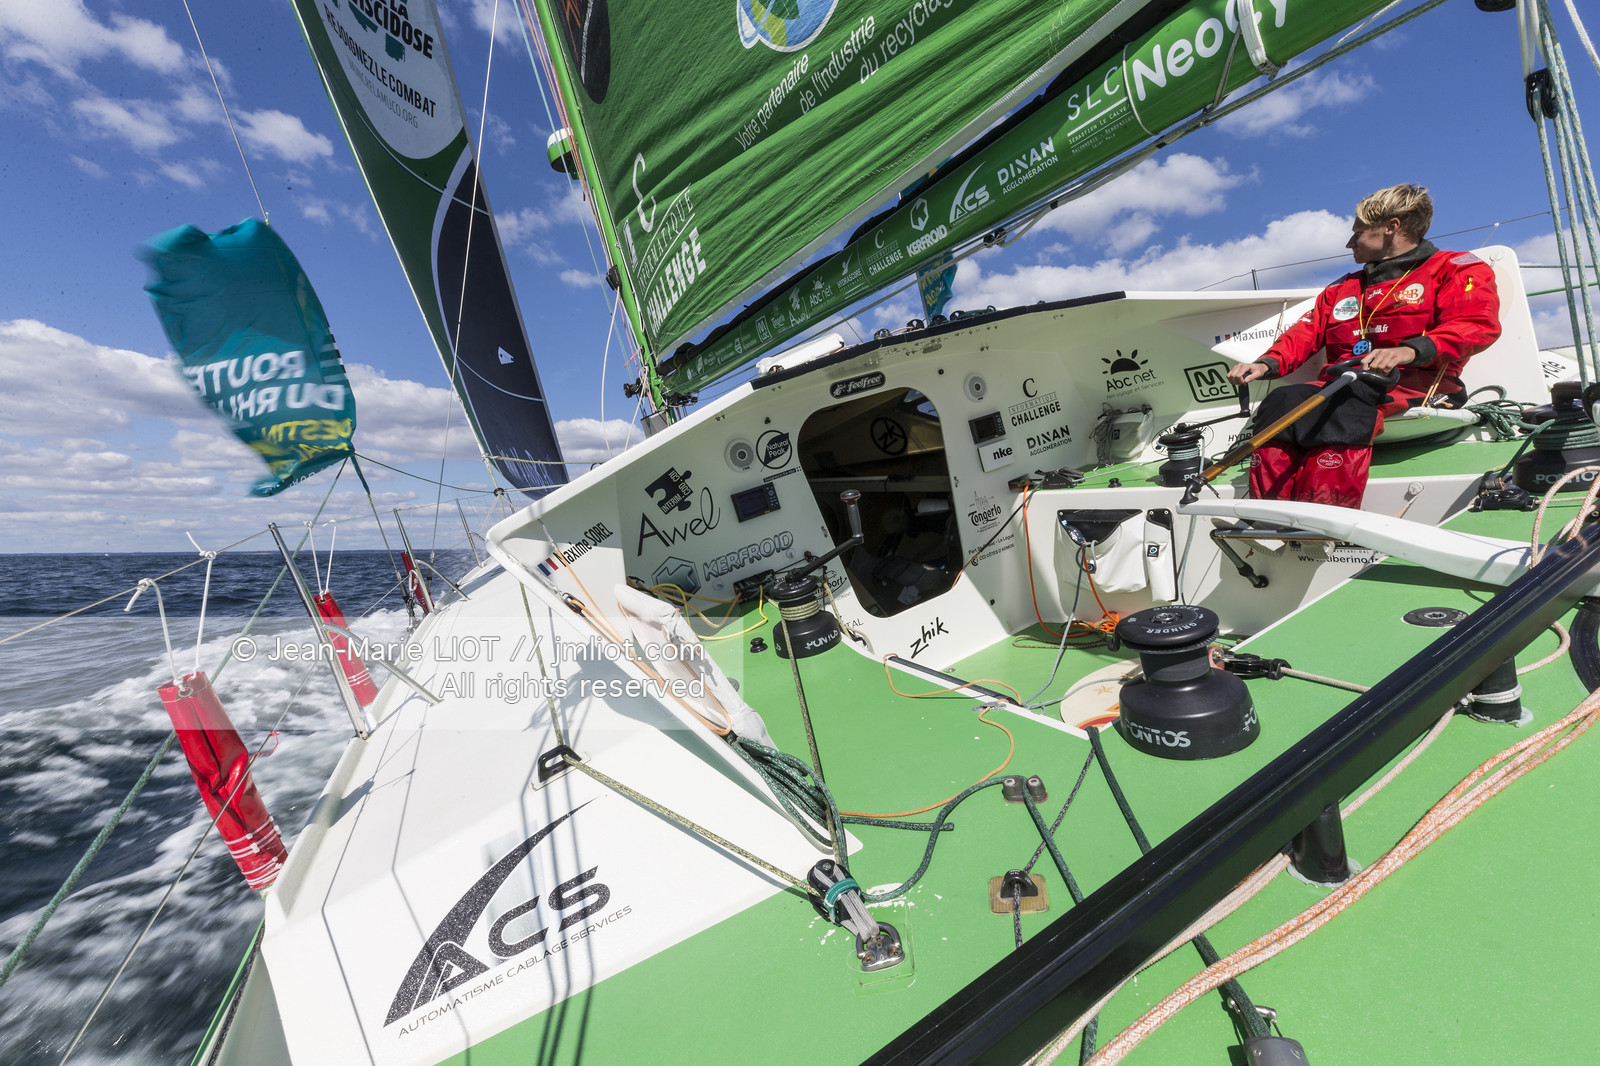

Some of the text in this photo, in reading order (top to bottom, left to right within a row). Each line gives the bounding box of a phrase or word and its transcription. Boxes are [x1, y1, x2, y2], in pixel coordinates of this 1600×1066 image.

[800, 15, 875, 115] de l'industrie
[860, 51, 879, 84] du
[735, 54, 809, 151] Votre partenaire
[997, 136, 1055, 186] DINAN
[1002, 155, 1058, 195] AGGLOMÉRATION
[950, 161, 990, 223] ACS
[906, 224, 948, 258] KERFROID
[868, 249, 904, 276] CHALLENGE
[646, 227, 706, 338] CHALLENGE
[1233, 327, 1275, 343] Maxime
[1008, 391, 1058, 414] INFORMATIQUE
[1022, 378, 1038, 398] C
[1200, 384, 1230, 398] LOC
[1011, 401, 1061, 427] CHALLENGE
[767, 438, 789, 450] Natural
[1026, 425, 1070, 449] DINAN
[1029, 438, 1073, 457] AGGLOMÉRATION
[768, 447, 786, 458] Peak
[993, 447, 1013, 460] nke
[637, 486, 720, 556] Awel
[968, 504, 1001, 526] Tongerlo
[553, 522, 614, 567] Maxime SOREL
[702, 530, 793, 581] KERFROID
[1146, 623, 1198, 634] GRINDER
[383, 794, 611, 1027] ACS
[398, 905, 632, 1039] AUTOMATISME CABLAGE SERVICES
